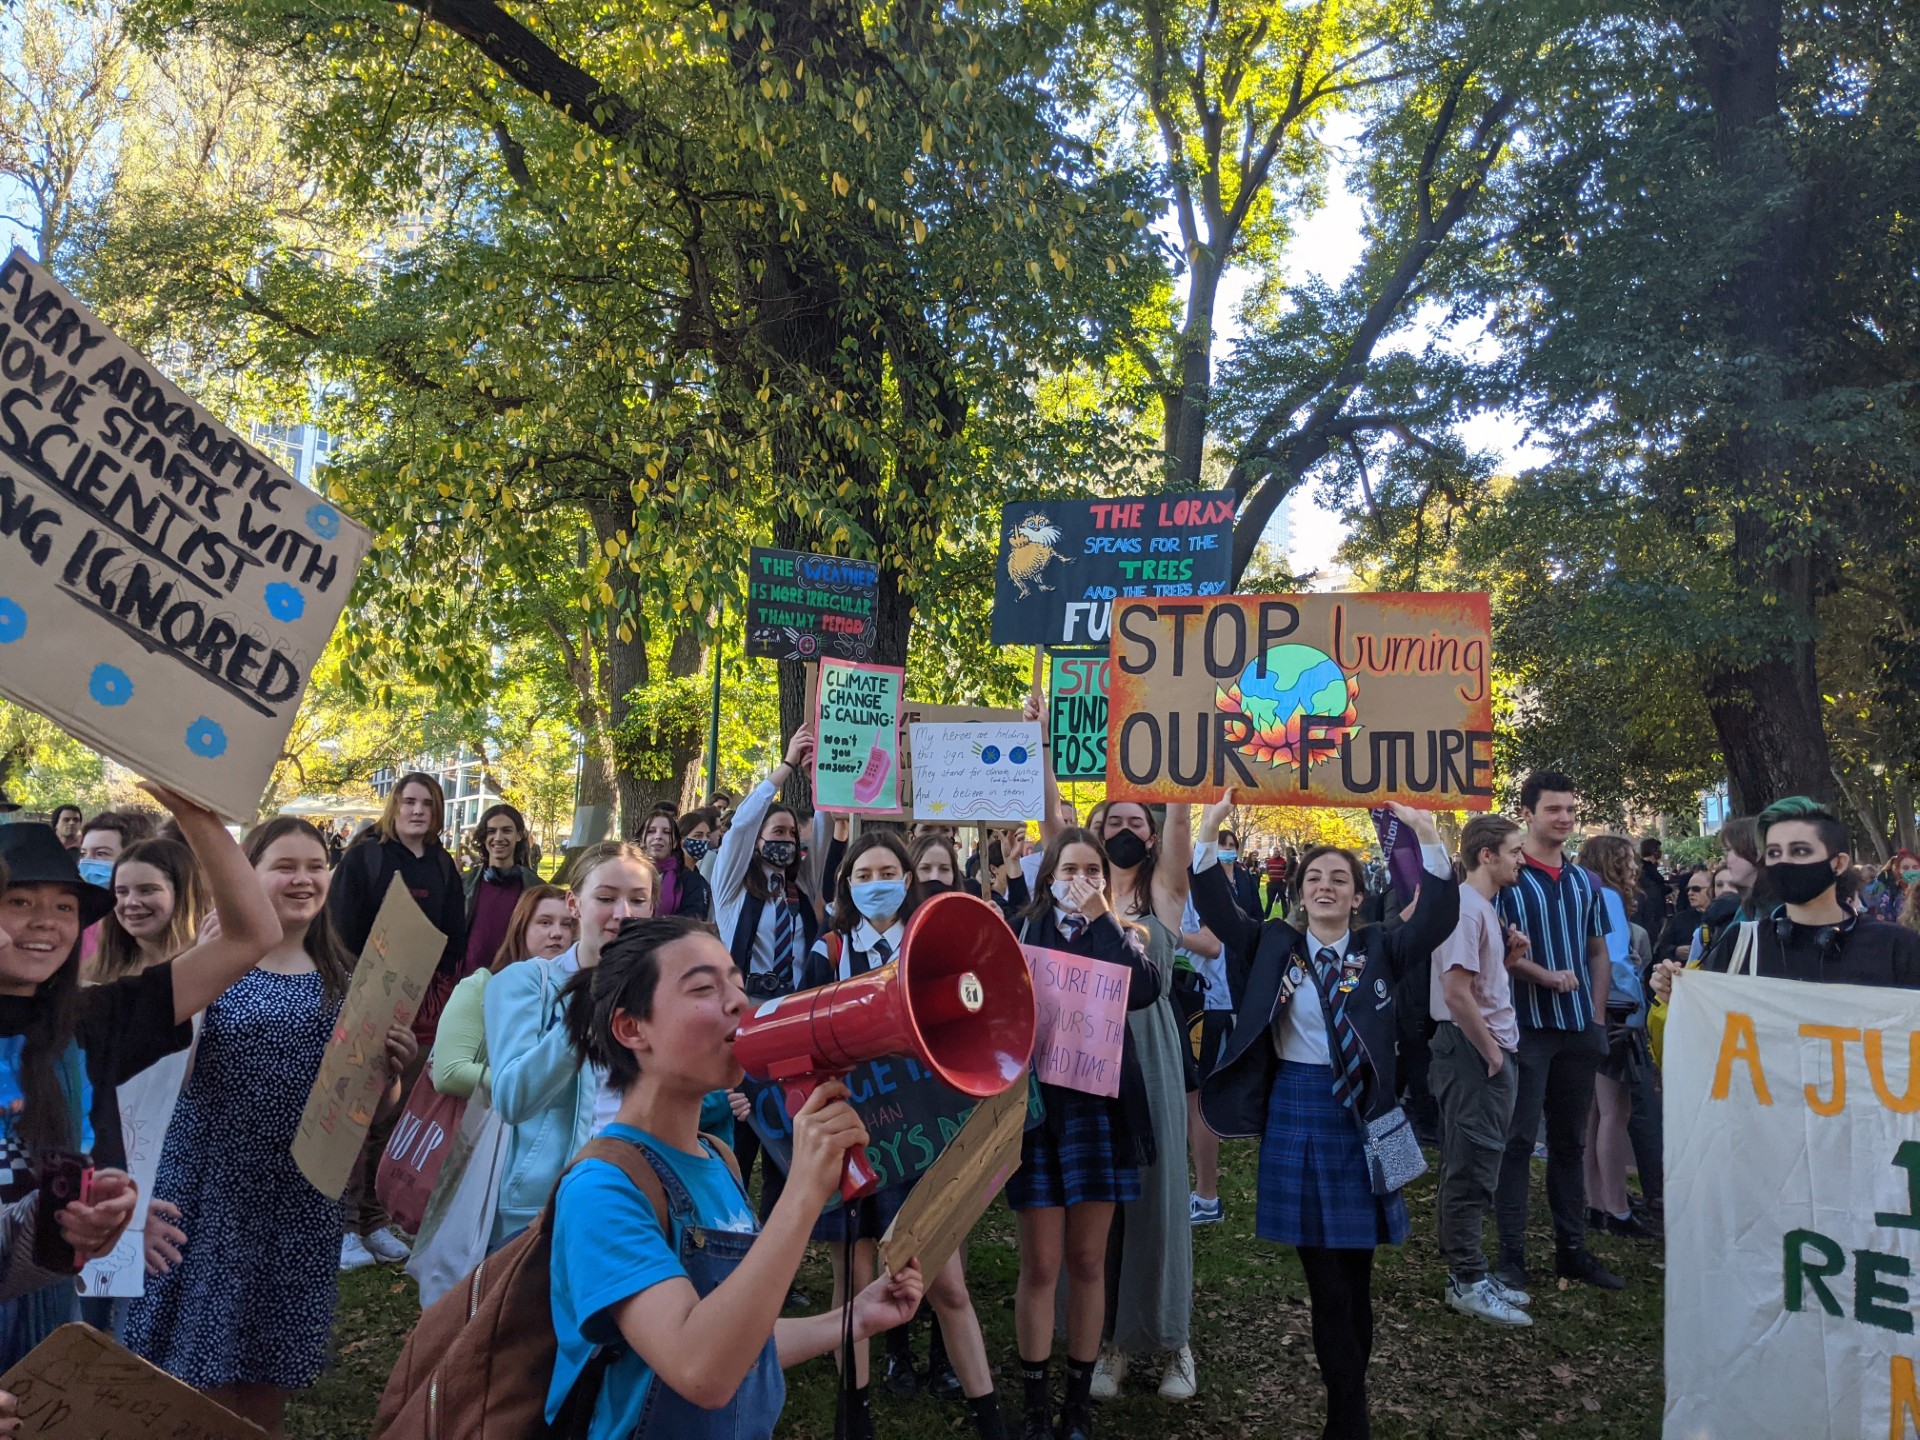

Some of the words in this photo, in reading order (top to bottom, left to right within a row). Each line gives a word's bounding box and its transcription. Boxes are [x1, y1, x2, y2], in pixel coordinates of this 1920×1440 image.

[0, 258, 106, 366] EVERY
[0, 387, 265, 593] SCIENTIST
[98, 406, 234, 522] STARTS
[238, 501, 339, 593] WITH
[1089, 503, 1145, 529] THE
[1158, 498, 1236, 527] LORAX
[1084, 536, 1142, 554] SPEAKS
[1150, 537, 1181, 553] FOR
[1188, 534, 1219, 551] THE
[759, 556, 794, 578] THE
[803, 561, 877, 587] WEATHER
[1118, 558, 1194, 581] TREES
[751, 582, 767, 599] IS
[770, 584, 804, 605] MORE
[806, 589, 871, 616] IRREGULAR
[1083, 586, 1117, 600] AND
[1122, 586, 1148, 598] THE
[1153, 583, 1193, 597] TREES
[1197, 581, 1226, 596] SAY
[63, 529, 300, 703] IGNORED
[822, 614, 864, 635] PERIOD
[1063, 602, 1111, 642] FU
[1118, 601, 1300, 680] STOP
[826, 670, 889, 694] CLIMATE
[827, 689, 882, 710] CHANGE
[820, 704, 831, 720] IS
[835, 708, 894, 727] CALLING:
[824, 734, 857, 748] won't
[915, 726, 934, 750] My
[942, 727, 972, 741] heroes
[976, 731, 988, 739] are
[996, 728, 1029, 745] holding
[831, 748, 851, 761] you
[917, 749, 934, 760] this
[1118, 710, 1260, 788] OUR
[1300, 714, 1492, 796] FUTURE
[818, 760, 862, 774] answer?
[914, 764, 936, 783] They
[941, 767, 966, 778] stand
[969, 766, 981, 780] for
[915, 786, 931, 803] And
[952, 786, 984, 799] believe
[1003, 788, 1025, 797] them
[1045, 961, 1091, 995] SURE
[1038, 1040, 1070, 1074] HAD
[1075, 1050, 1110, 1083] TIME
[1711, 1011, 1774, 1106] A
